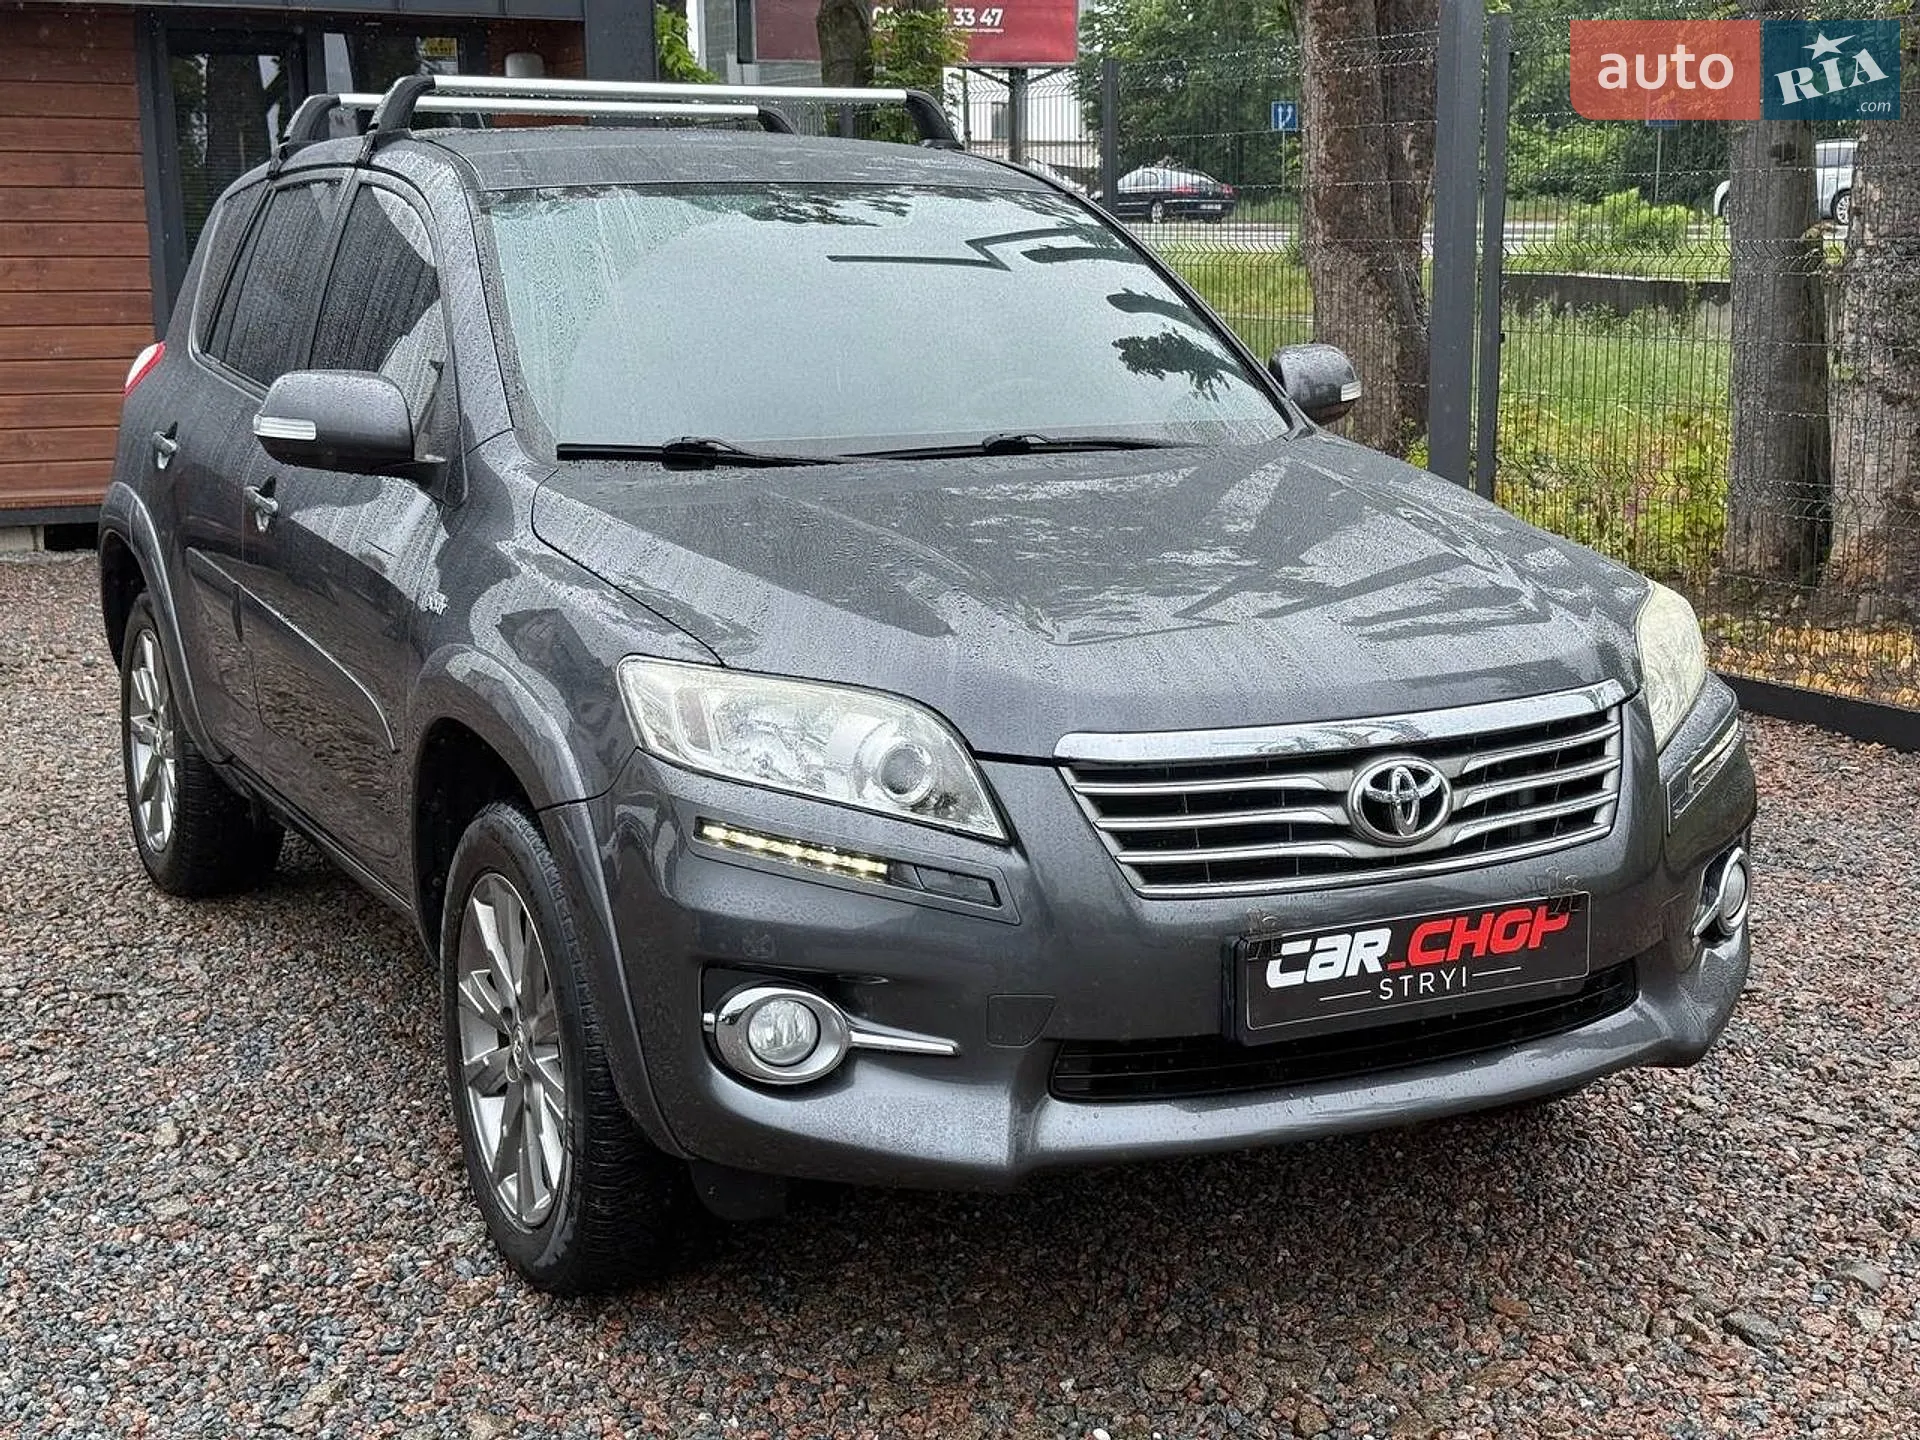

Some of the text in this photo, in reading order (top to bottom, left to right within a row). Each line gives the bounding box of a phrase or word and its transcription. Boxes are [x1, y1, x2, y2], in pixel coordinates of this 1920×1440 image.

[953, 7, 976, 27] 33
[979, 7, 1004, 27] 47
[1379, 966, 1467, 1000] STRYI
